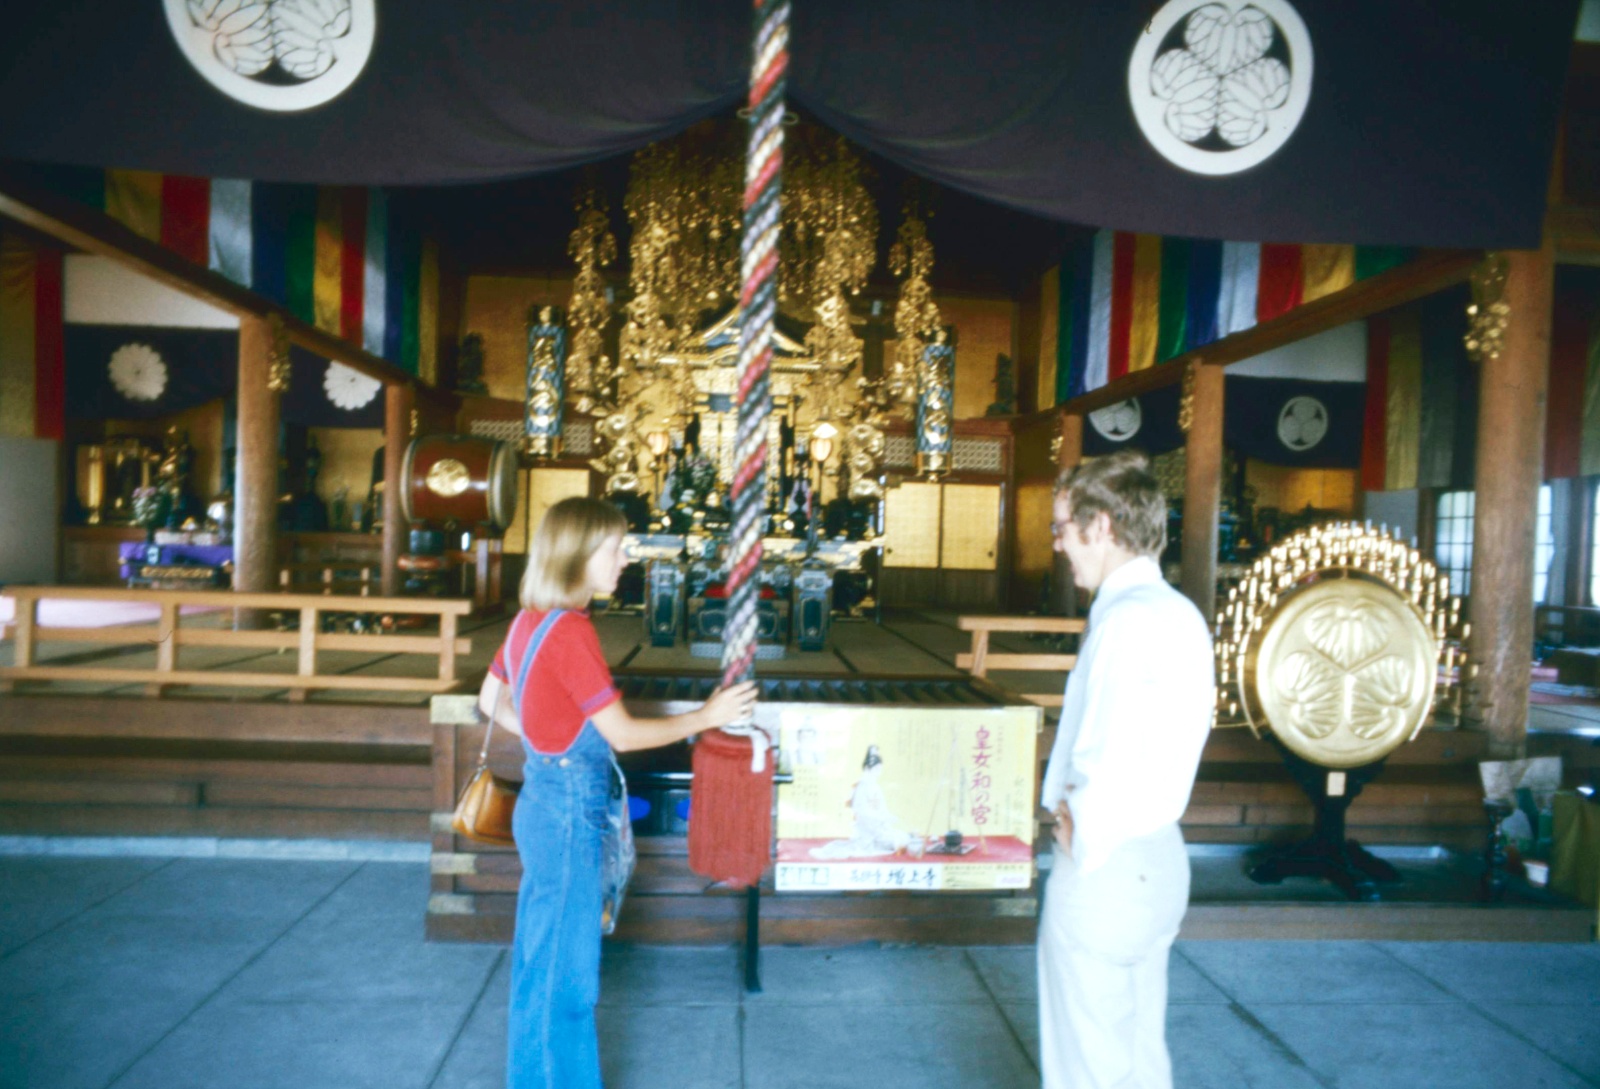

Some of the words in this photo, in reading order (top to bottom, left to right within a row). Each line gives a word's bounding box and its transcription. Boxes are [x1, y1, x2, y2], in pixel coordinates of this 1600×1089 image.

[970, 725, 993, 826] 皇女和の宮
